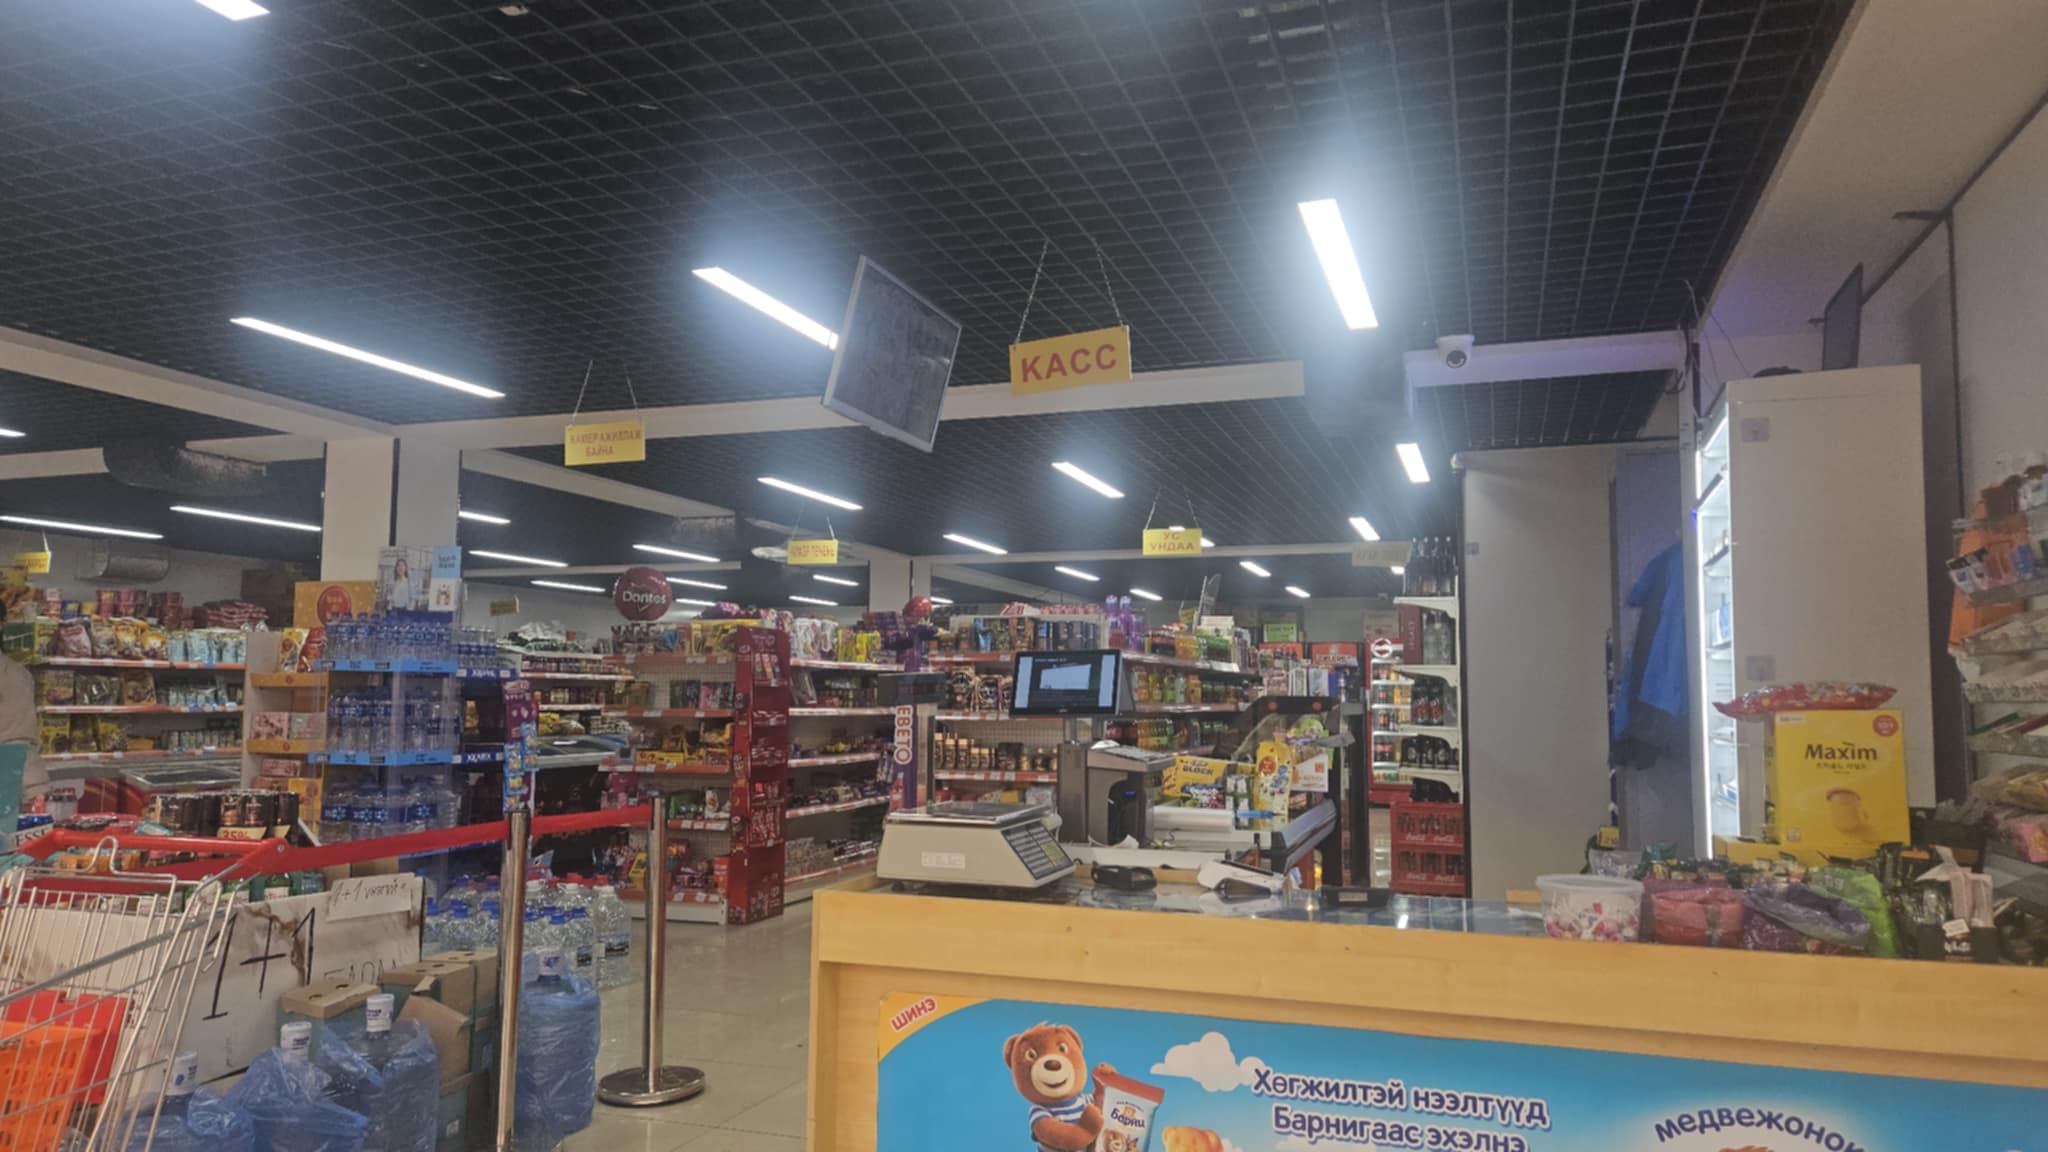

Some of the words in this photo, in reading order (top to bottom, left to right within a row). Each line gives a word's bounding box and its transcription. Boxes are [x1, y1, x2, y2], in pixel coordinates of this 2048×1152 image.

[1021, 343, 1117, 383] КАСС
[585, 444, 614, 456] БАЙНА
[1163, 532, 1180, 540] УС
[1150, 542, 1195, 551] УНДАА
[622, 590, 666, 604] Doritos
[1805, 742, 1877, 761] Maxim
[891, 998, 936, 1031] ШИНЭ
[1253, 1068, 1405, 1106] Хөгжилтэй
[1413, 1087, 1549, 1126] нээлтүүд
[1274, 1107, 1423, 1145] Барнигаас
[1427, 1125, 1526, 1152] эхэлнэ
